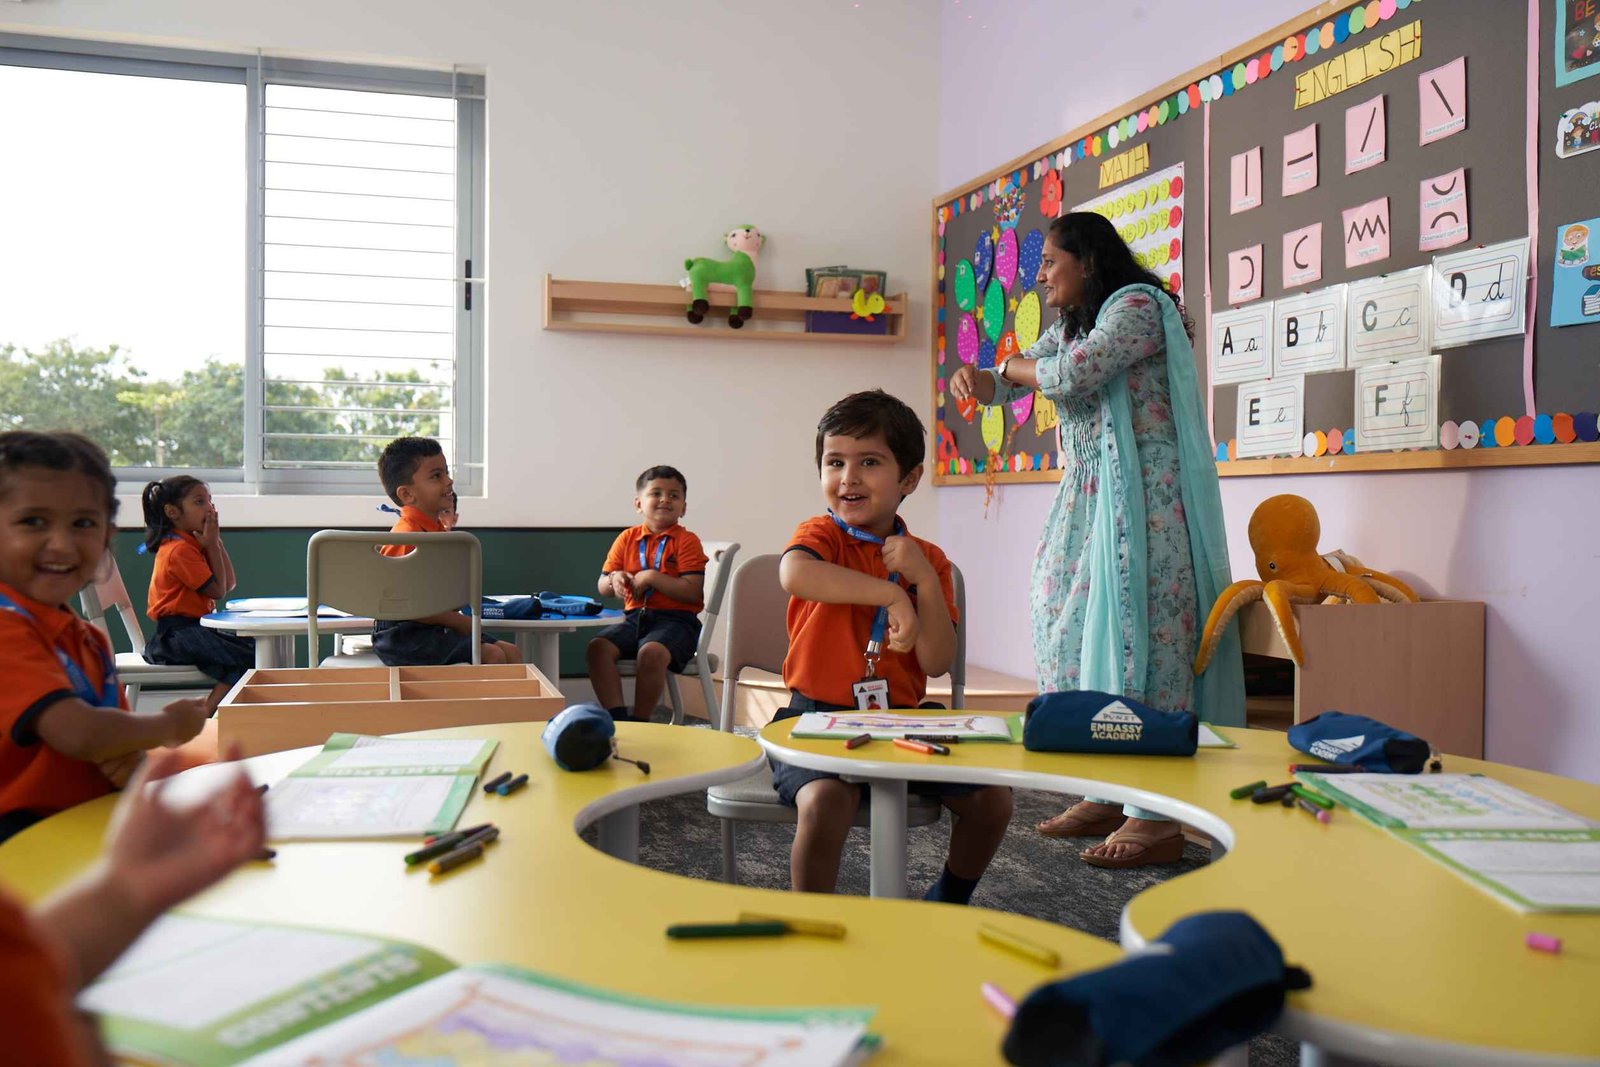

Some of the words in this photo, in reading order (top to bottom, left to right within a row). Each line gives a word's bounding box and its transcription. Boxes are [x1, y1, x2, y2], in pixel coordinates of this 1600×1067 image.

[1297, 21, 1416, 108] ENGLISH
[1588, 120, 1600, 131] CL
[1101, 144, 1145, 187] MATH
[1481, 262, 1505, 302] d
[1286, 316, 1299, 348] B
[1315, 310, 1328, 343] b
[1362, 299, 1378, 332] C
[1221, 326, 1234, 356] A
[1244, 337, 1259, 353] a
[1249, 397, 1261, 426] E
[1273, 406, 1287, 424] e
[1375, 384, 1389, 417] F
[1399, 381, 1413, 428] f
[1090, 722, 1143, 734] EMBASSY
[1091, 731, 1141, 741] ACADEMY
